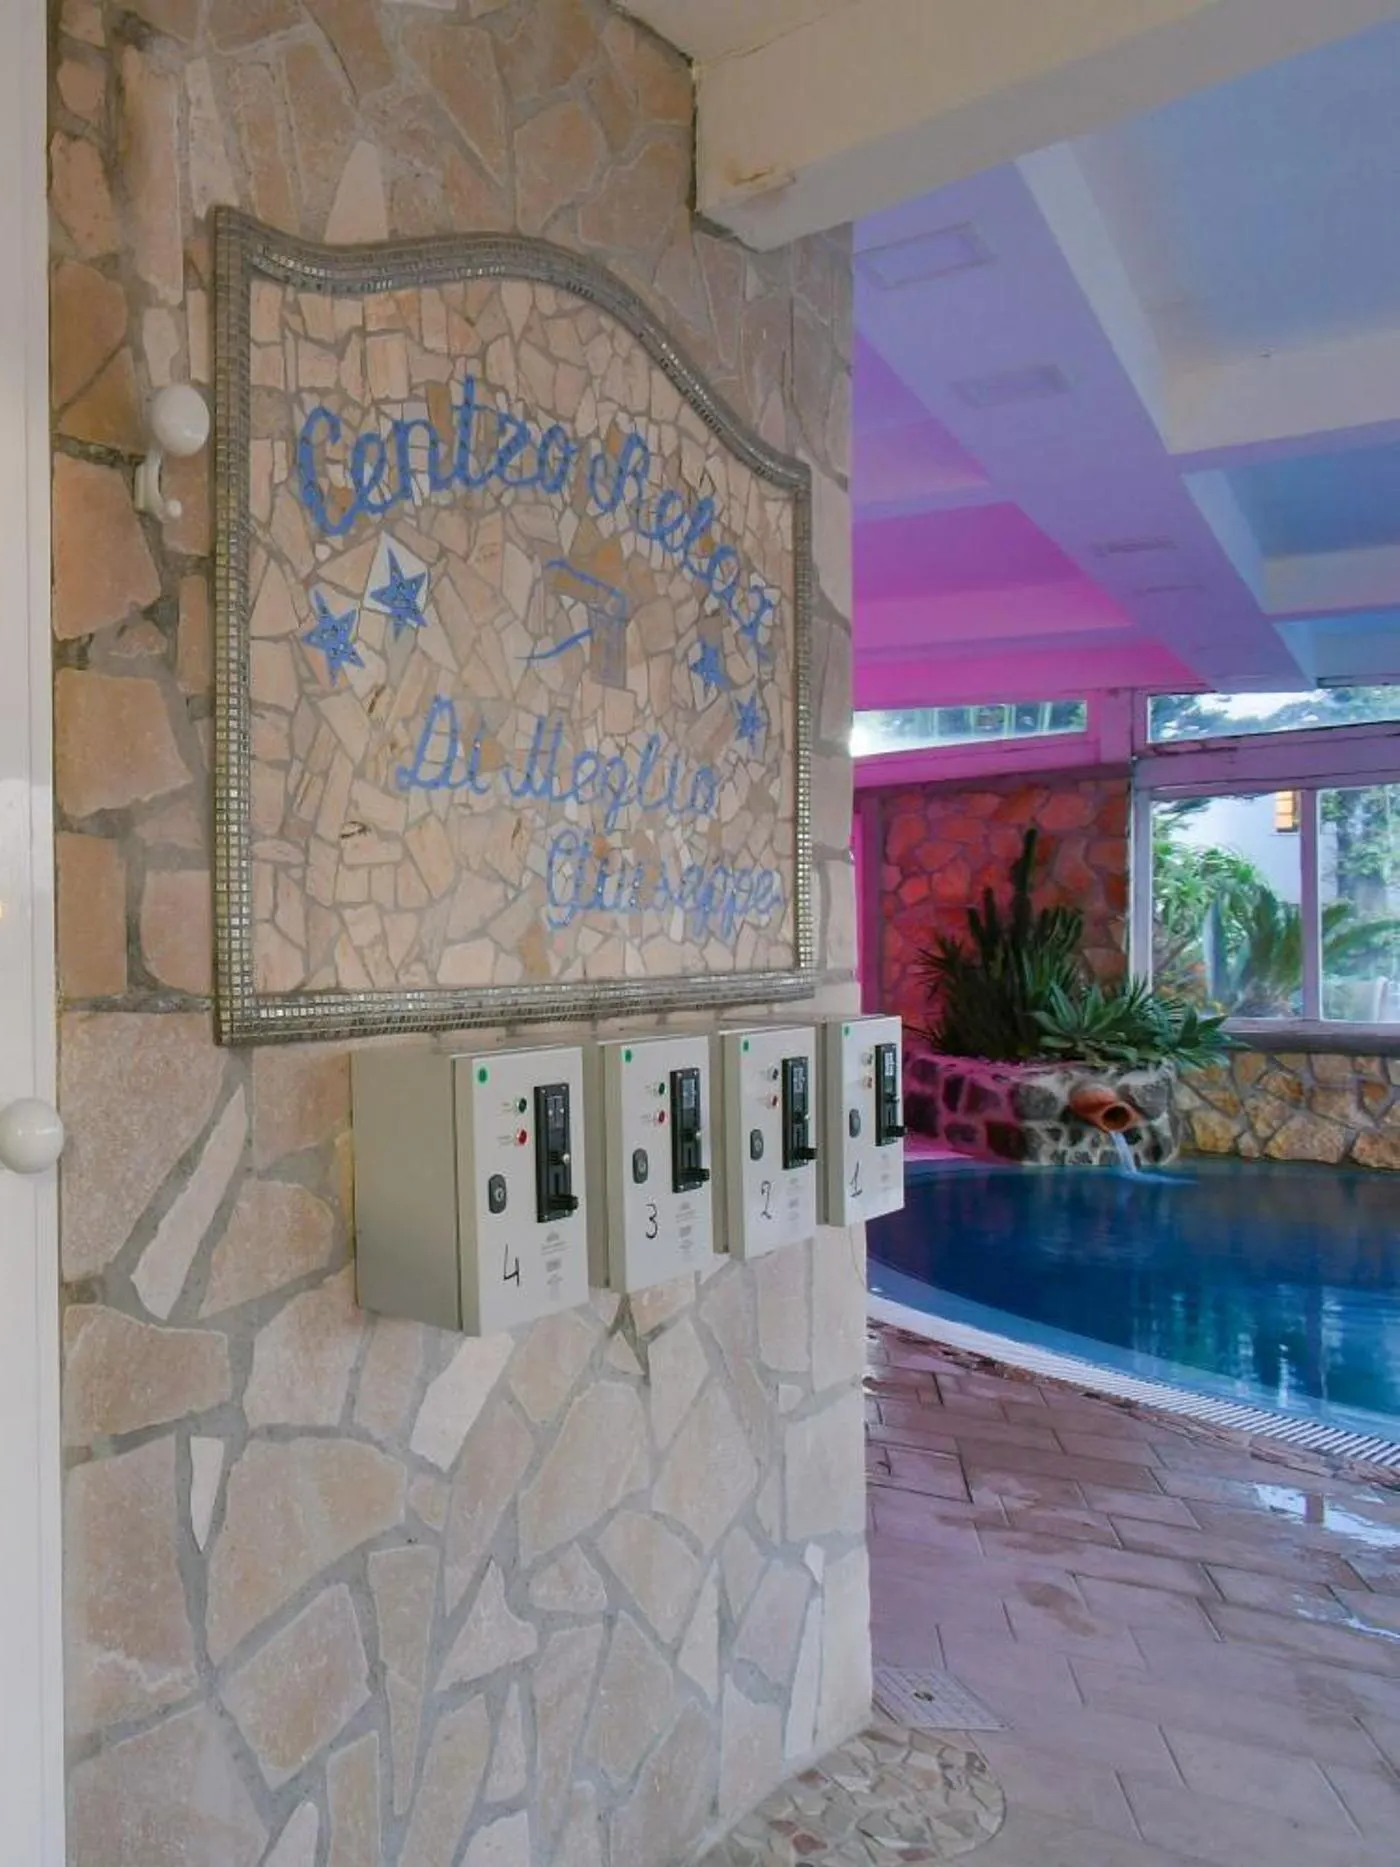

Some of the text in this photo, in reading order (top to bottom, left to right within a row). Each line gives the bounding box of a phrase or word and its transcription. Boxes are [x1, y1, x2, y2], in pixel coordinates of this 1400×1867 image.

[296, 374, 579, 537] Centro
[644, 1202, 659, 1240] 3
[759, 1180, 773, 1220] 2
[502, 1243, 521, 1288] 4
